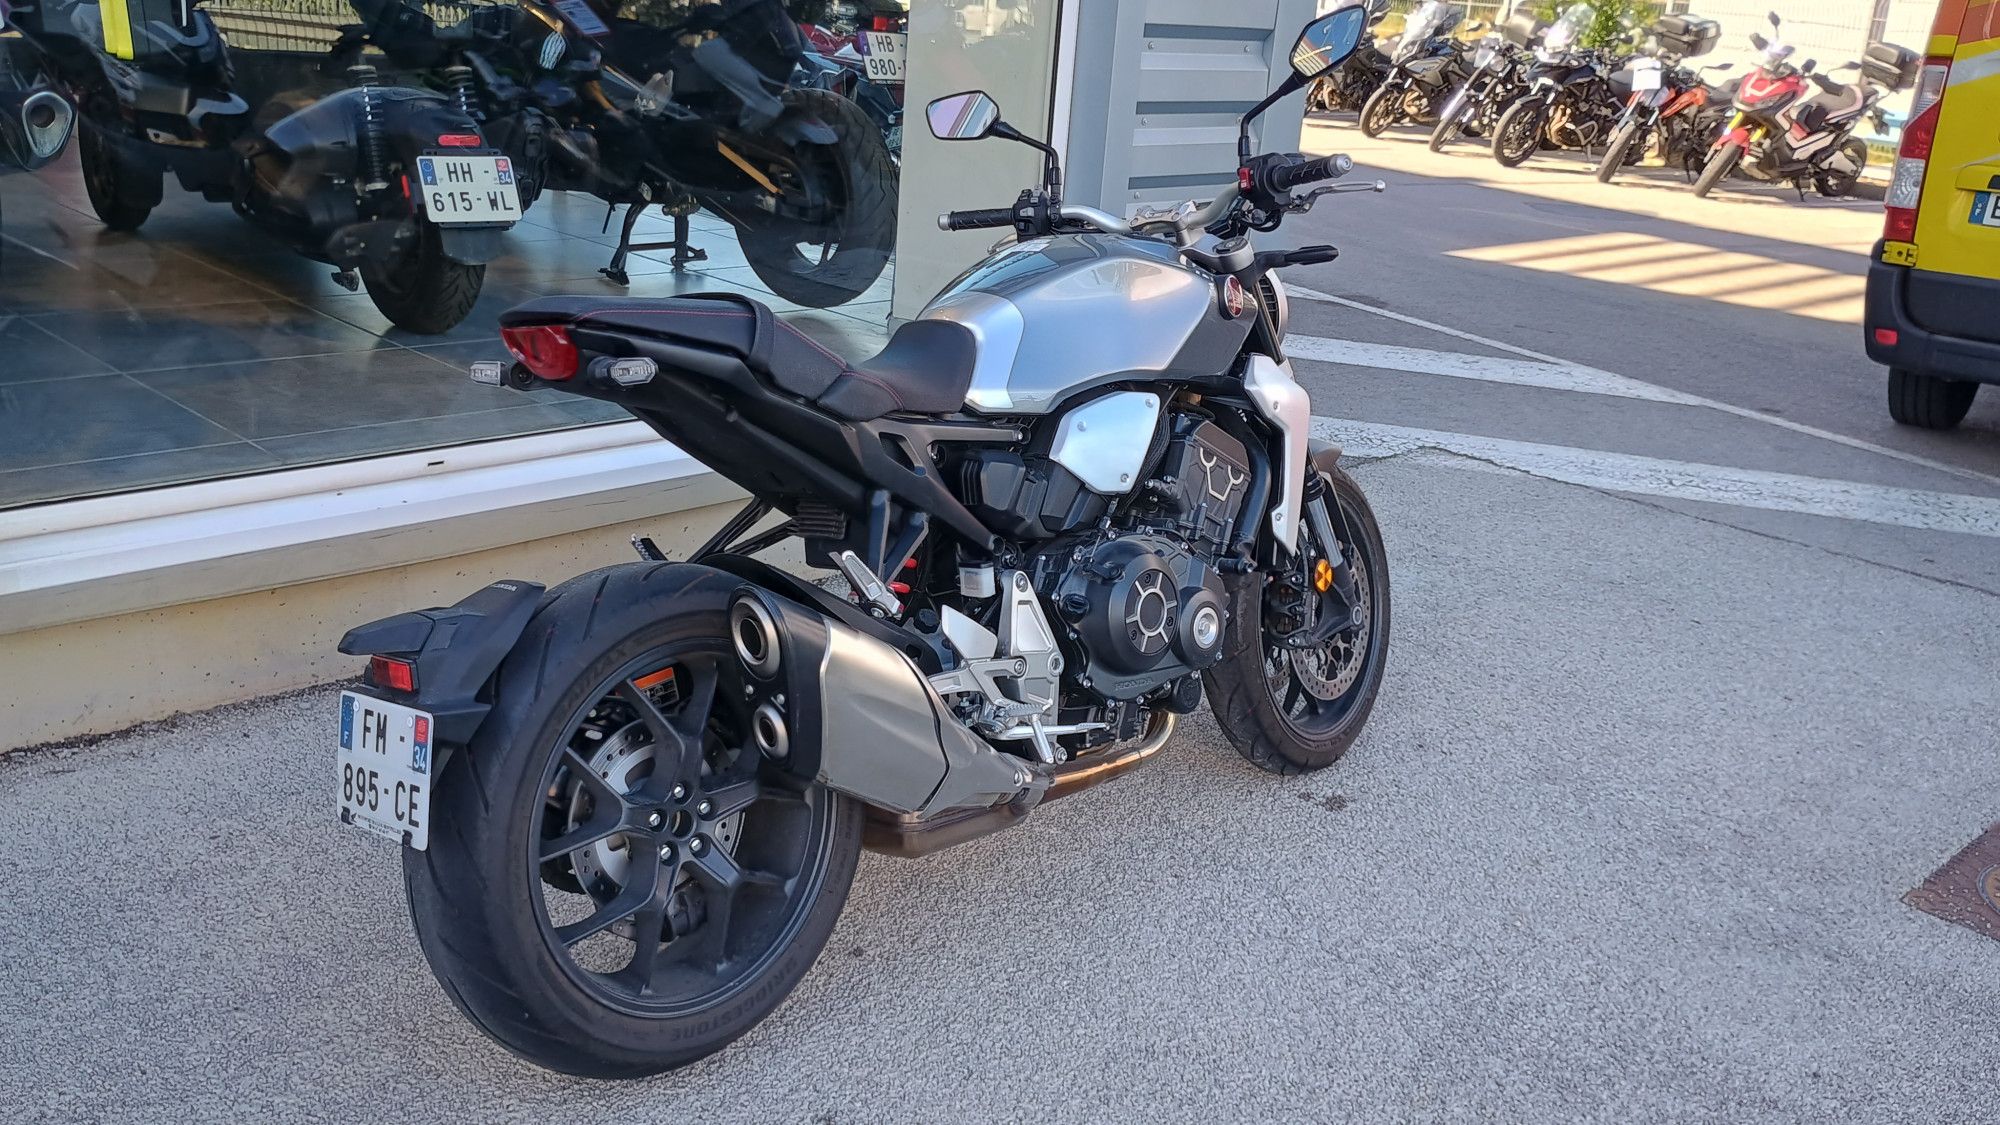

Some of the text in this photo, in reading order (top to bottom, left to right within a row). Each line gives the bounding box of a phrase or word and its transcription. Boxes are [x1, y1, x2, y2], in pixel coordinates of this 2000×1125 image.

[875, 35, 894, 52] HB
[869, 58, 906, 76] 980-
[446, 162, 474, 183] HH
[498, 171, 512, 183] 34
[432, 190, 514, 212] 615-WL
[1114, 677, 1155, 691] HONDA
[343, 731, 350, 744] F
[362, 709, 387, 755] FM
[413, 745, 426, 771] 34
[343, 762, 421, 829] 895-CE
